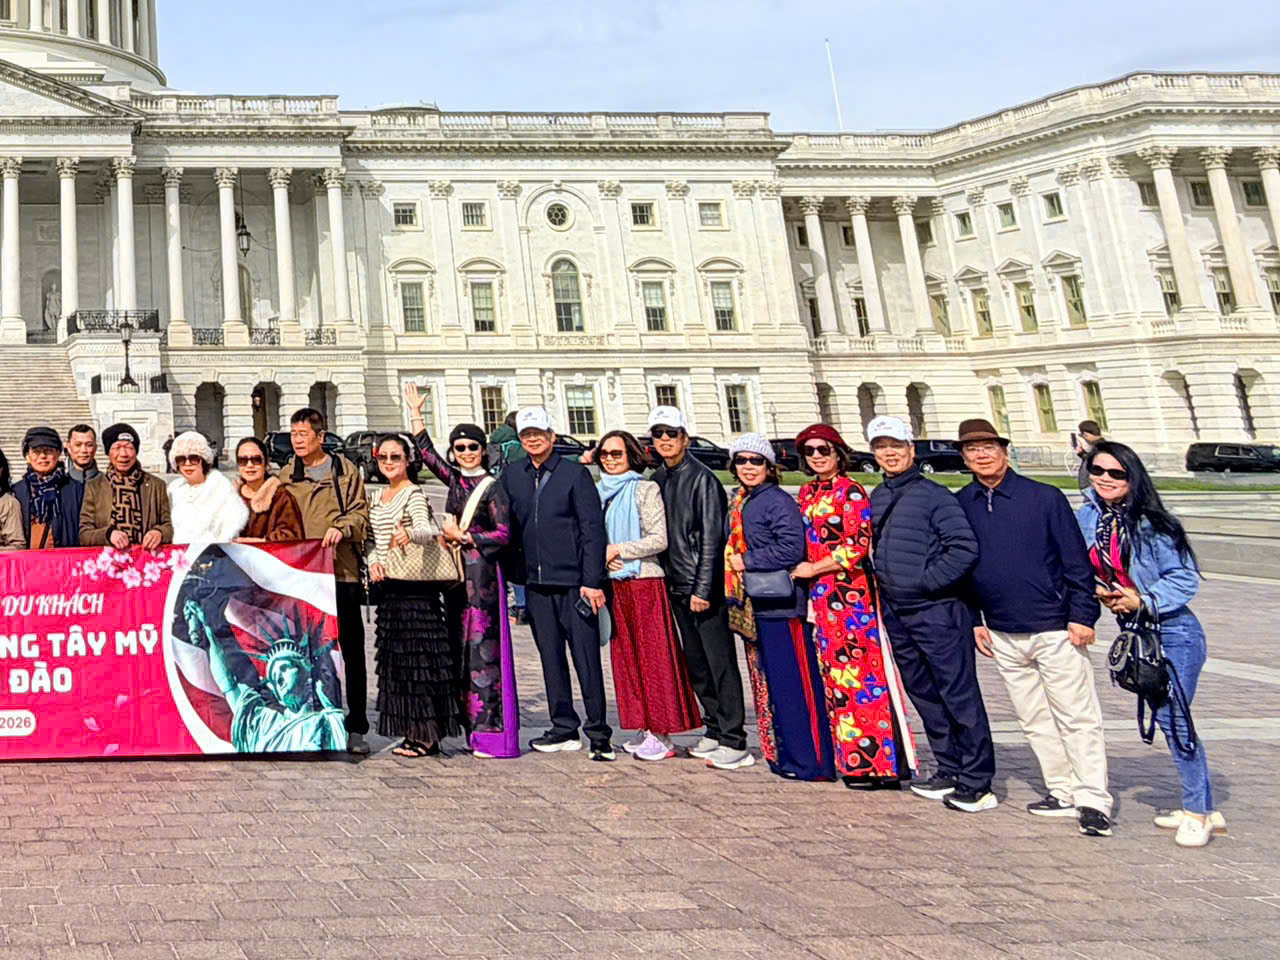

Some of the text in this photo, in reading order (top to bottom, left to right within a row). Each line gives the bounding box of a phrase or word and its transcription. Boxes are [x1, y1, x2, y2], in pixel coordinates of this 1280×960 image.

[1, 594, 34, 617] DU
[35, 587, 104, 617] KHÁCH
[46, 625, 107, 657] TÂY
[115, 624, 158, 656] MỸ
[8, 661, 73, 694] ĐÀO
